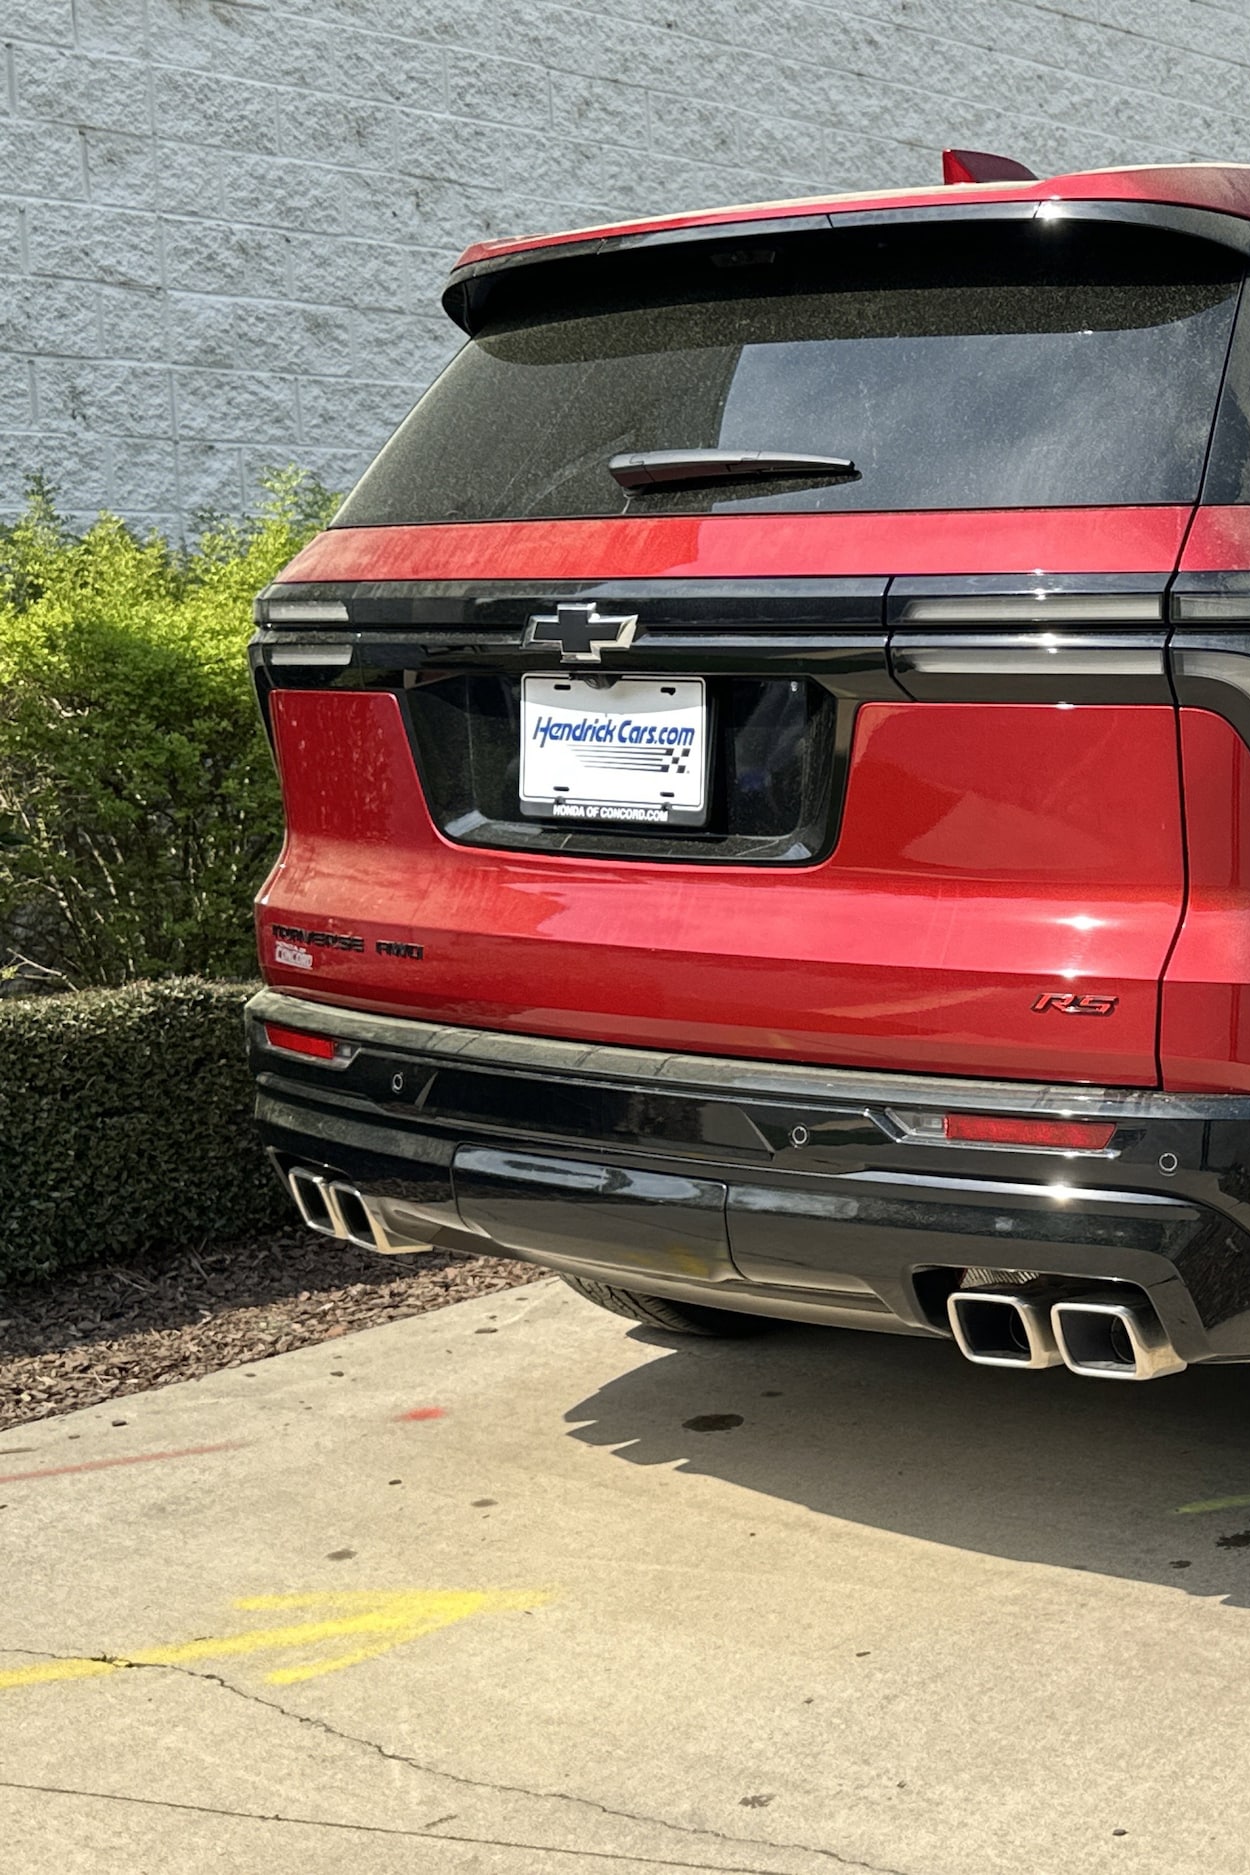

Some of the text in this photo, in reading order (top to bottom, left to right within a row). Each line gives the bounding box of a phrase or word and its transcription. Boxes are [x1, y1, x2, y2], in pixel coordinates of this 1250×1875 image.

[552, 803, 669, 822] HONDA OF CONCORD.COM
[1031, 992, 1120, 1017] RS
